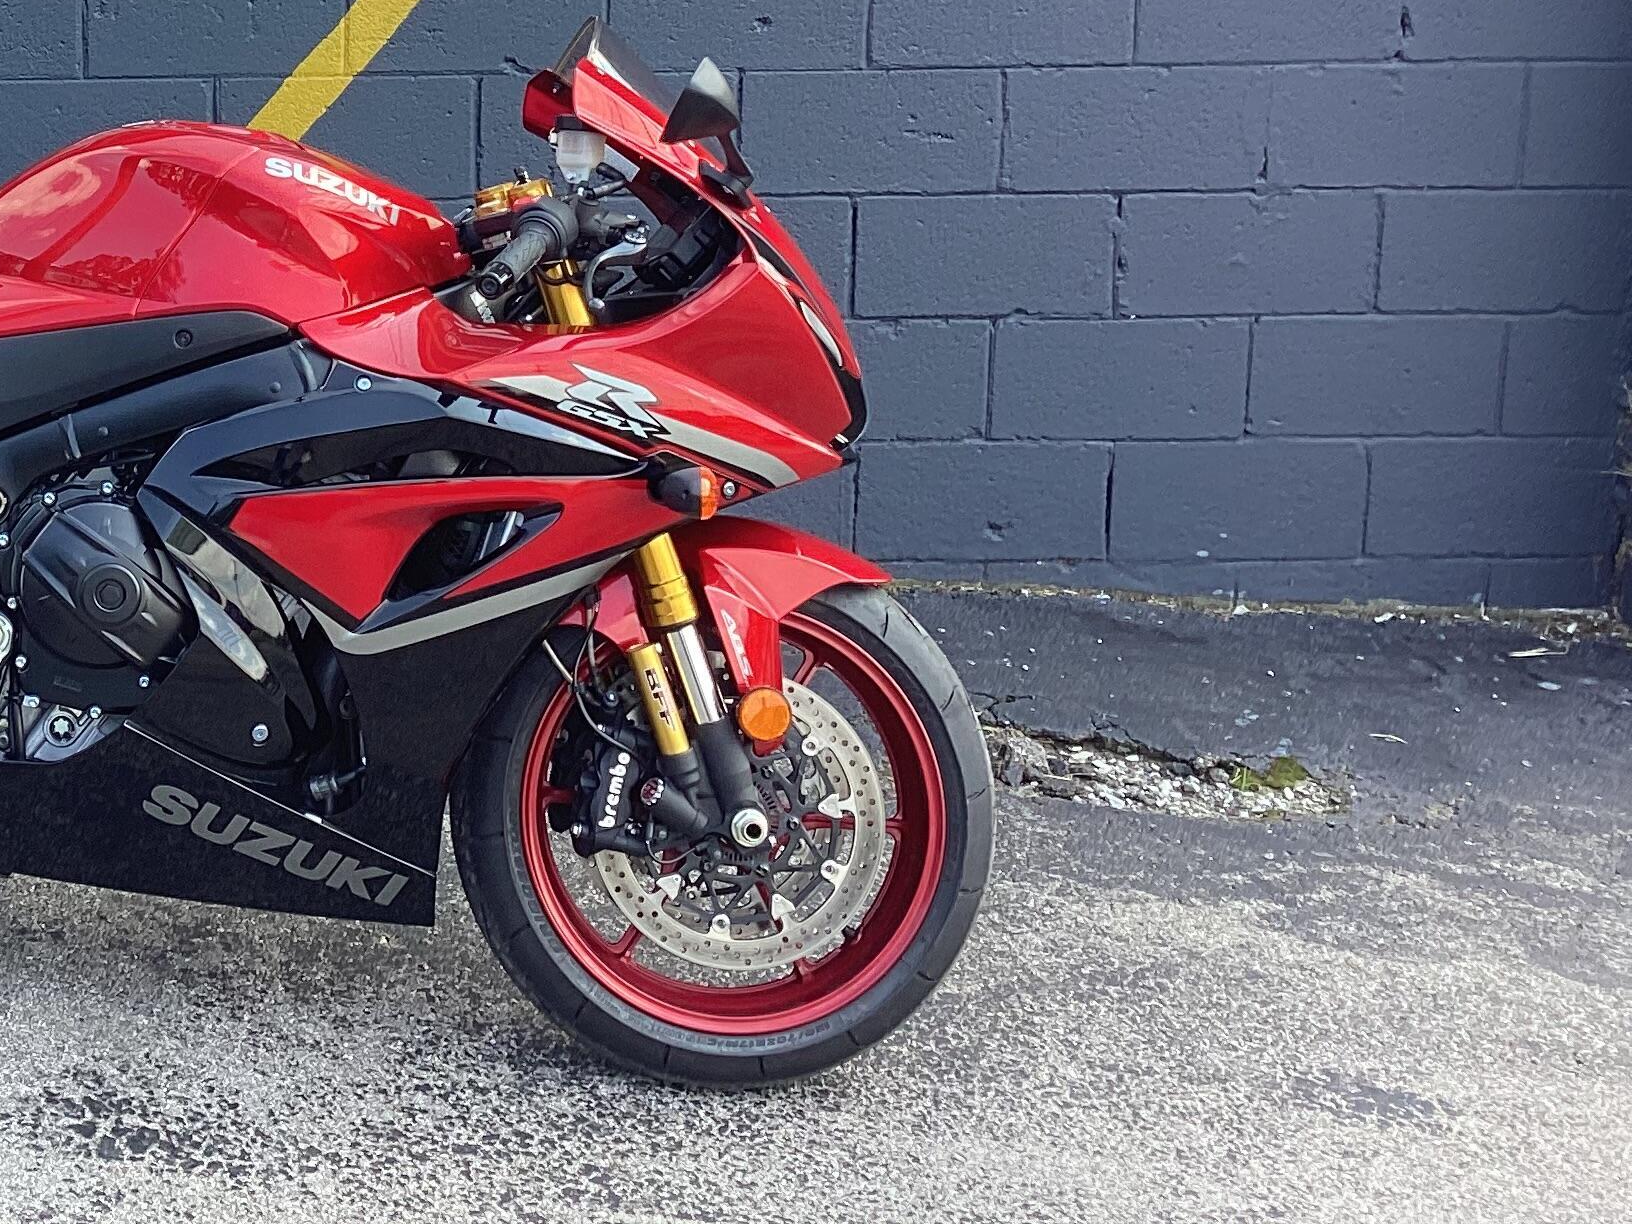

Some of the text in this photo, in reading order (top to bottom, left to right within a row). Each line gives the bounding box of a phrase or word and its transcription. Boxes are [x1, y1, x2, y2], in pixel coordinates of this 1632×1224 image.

[264, 157, 401, 226] SUZUKI
[556, 399, 660, 440] GSX
[720, 609, 754, 679] ABS
[598, 752, 631, 829] brembo
[142, 784, 409, 907] SUZUKI
